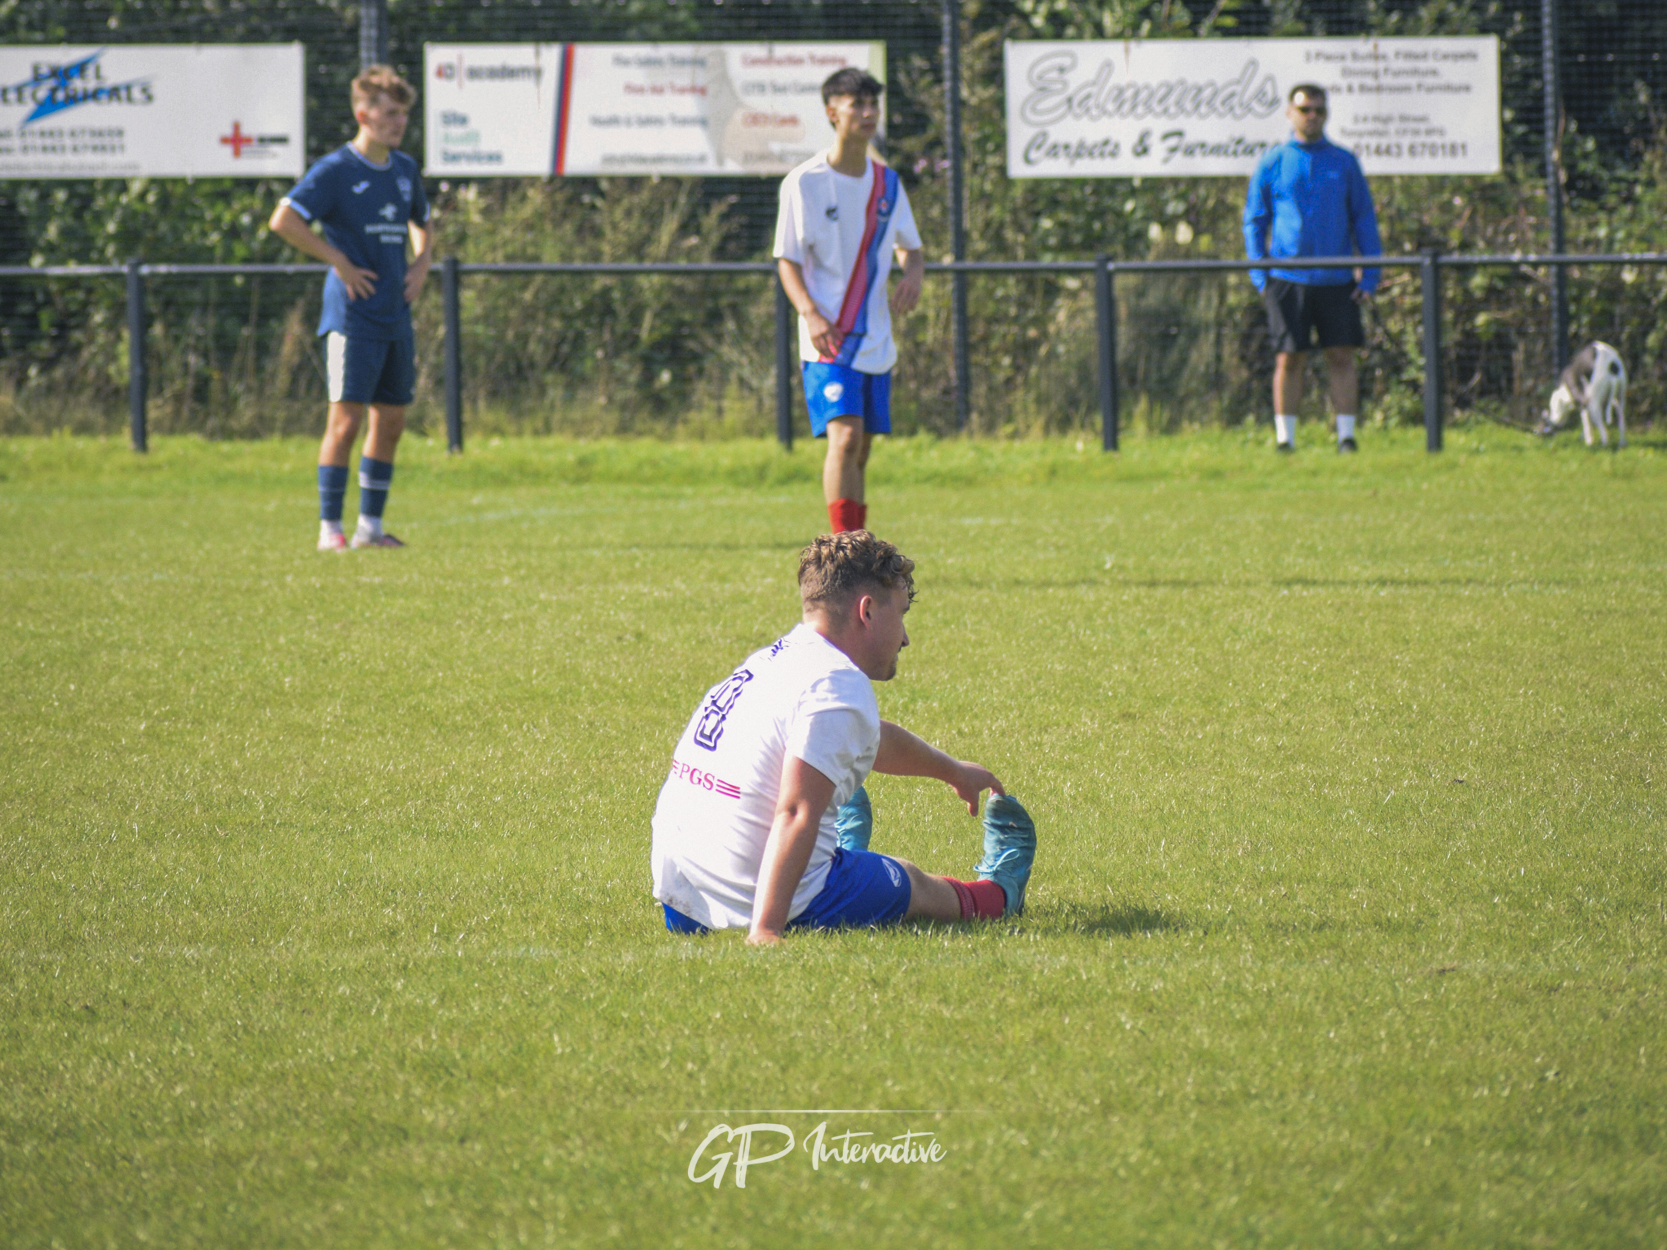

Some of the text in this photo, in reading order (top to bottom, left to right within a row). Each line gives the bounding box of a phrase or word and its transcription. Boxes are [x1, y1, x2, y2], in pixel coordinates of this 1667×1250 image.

[32, 62, 105, 82] EXCEL
[1020, 49, 1282, 127] Edmunds
[1416, 82, 1472, 95] Furniture
[1024, 129, 1121, 165] Carpets
[1131, 129, 1152, 157] &
[1353, 142, 1403, 159] 01443
